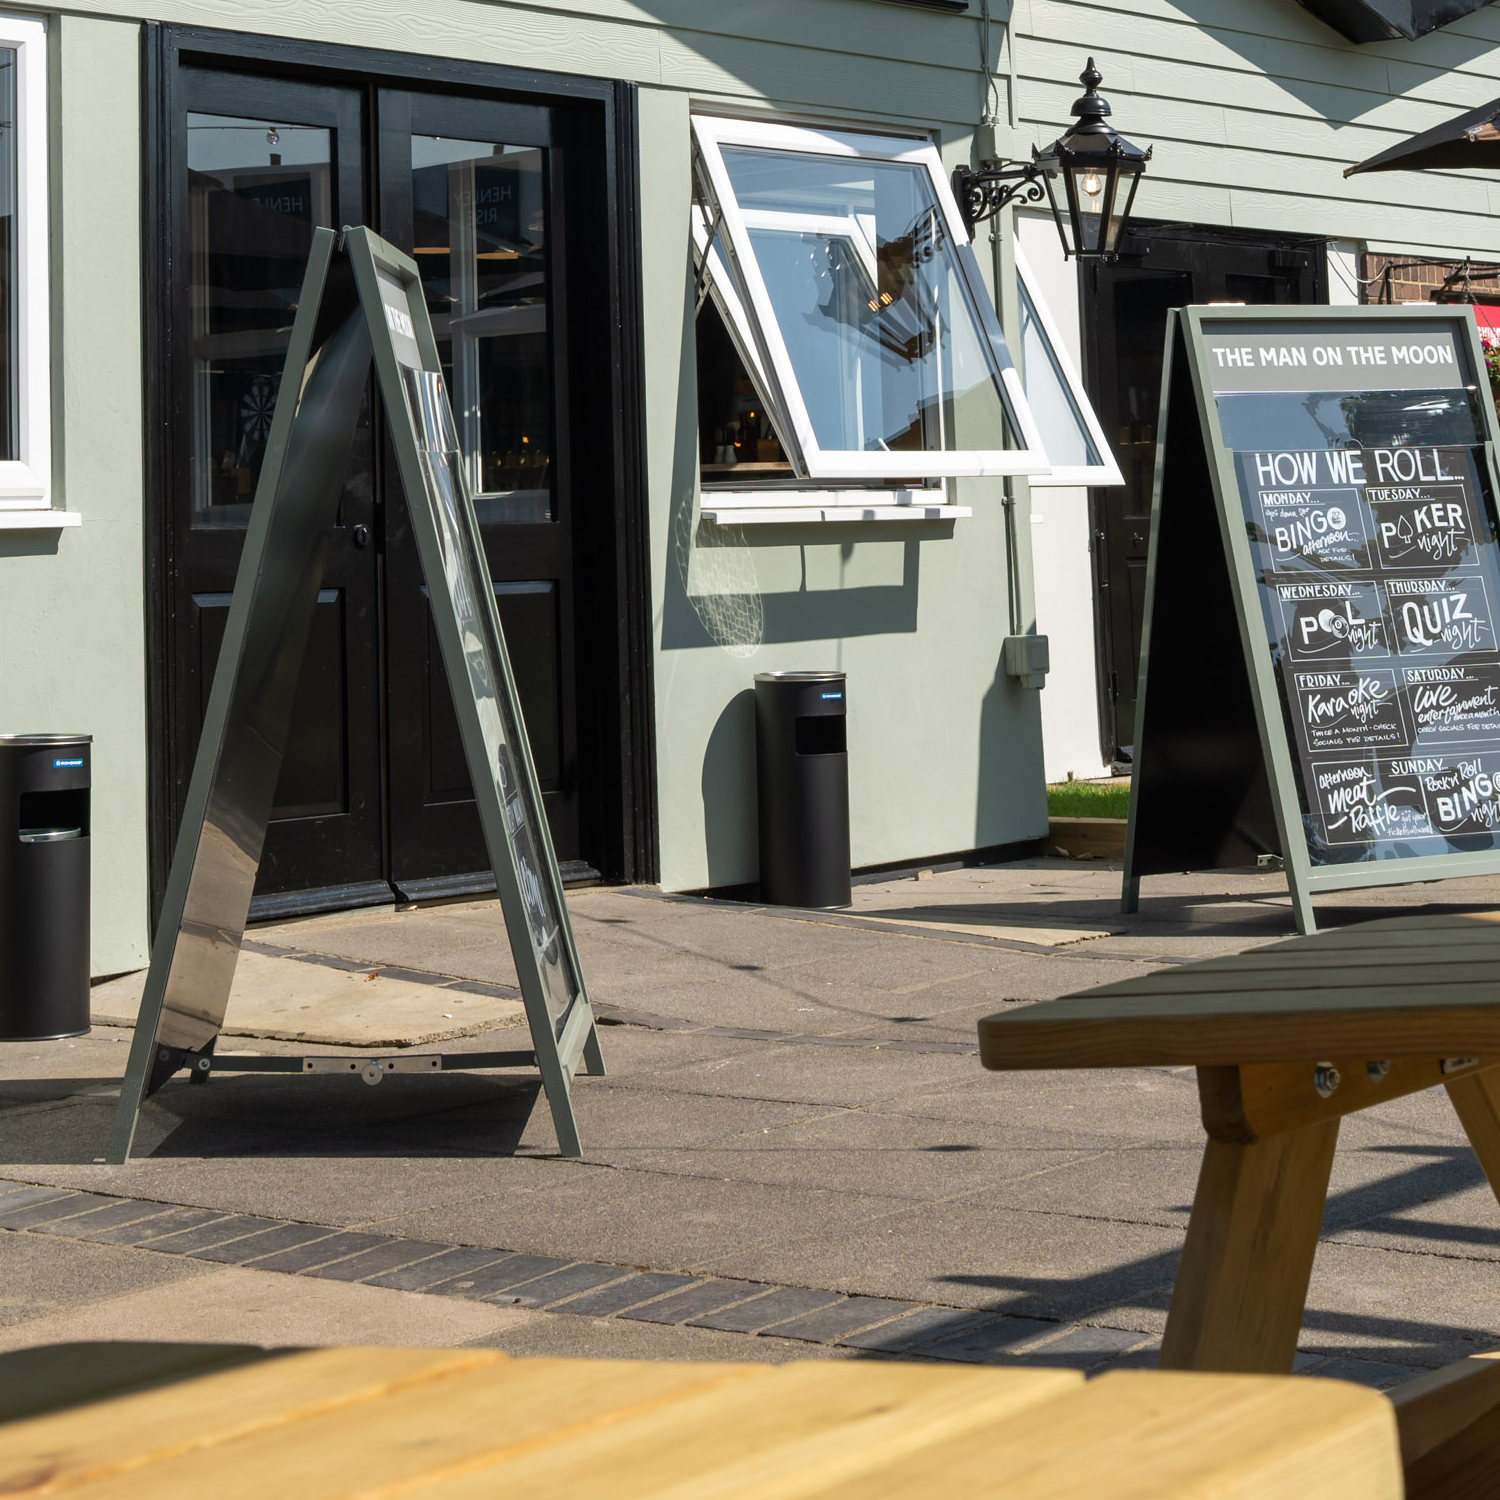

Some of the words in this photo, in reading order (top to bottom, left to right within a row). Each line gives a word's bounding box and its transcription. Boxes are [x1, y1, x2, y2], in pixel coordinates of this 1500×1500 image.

[1213, 347, 1254, 367] THE
[1259, 346, 1307, 366] MAN
[1312, 346, 1343, 366] ON
[1346, 346, 1388, 365] THE
[1392, 345, 1453, 364] MOON
[1255, 451, 1317, 486] HOW
[1325, 450, 1367, 484] WE
[1374, 448, 1465, 483] ROLL...
[1263, 492, 1320, 505] MONDAY...
[1368, 488, 1431, 501] TUESDAY...
[1417, 529, 1468, 560] night
[1280, 584, 1361, 599] WEDNESDAY...
[1388, 580, 1455, 593] THURSDAY...
[1402, 593, 1473, 646] QUIZ
[1347, 619, 1382, 652] night
[1439, 616, 1487, 650] night
[1299, 674, 1350, 688] FRIDAY...
[1407, 668, 1474, 682] SATURDAY...
[1350, 699, 1388, 723] night
[1417, 685, 1499, 724] entertainment
[1311, 729, 1333, 738] TWICE
[1438, 723, 1465, 732] SOCIALS
[1312, 737, 1344, 747] SOCIALS
[1346, 735, 1362, 744] FOR
[1364, 732, 1401, 742] DETAILS!
[1391, 758, 1449, 775] SUNDAY...
[1457, 758, 1483, 781] Roll
[1319, 766, 1373, 790] afternoon
